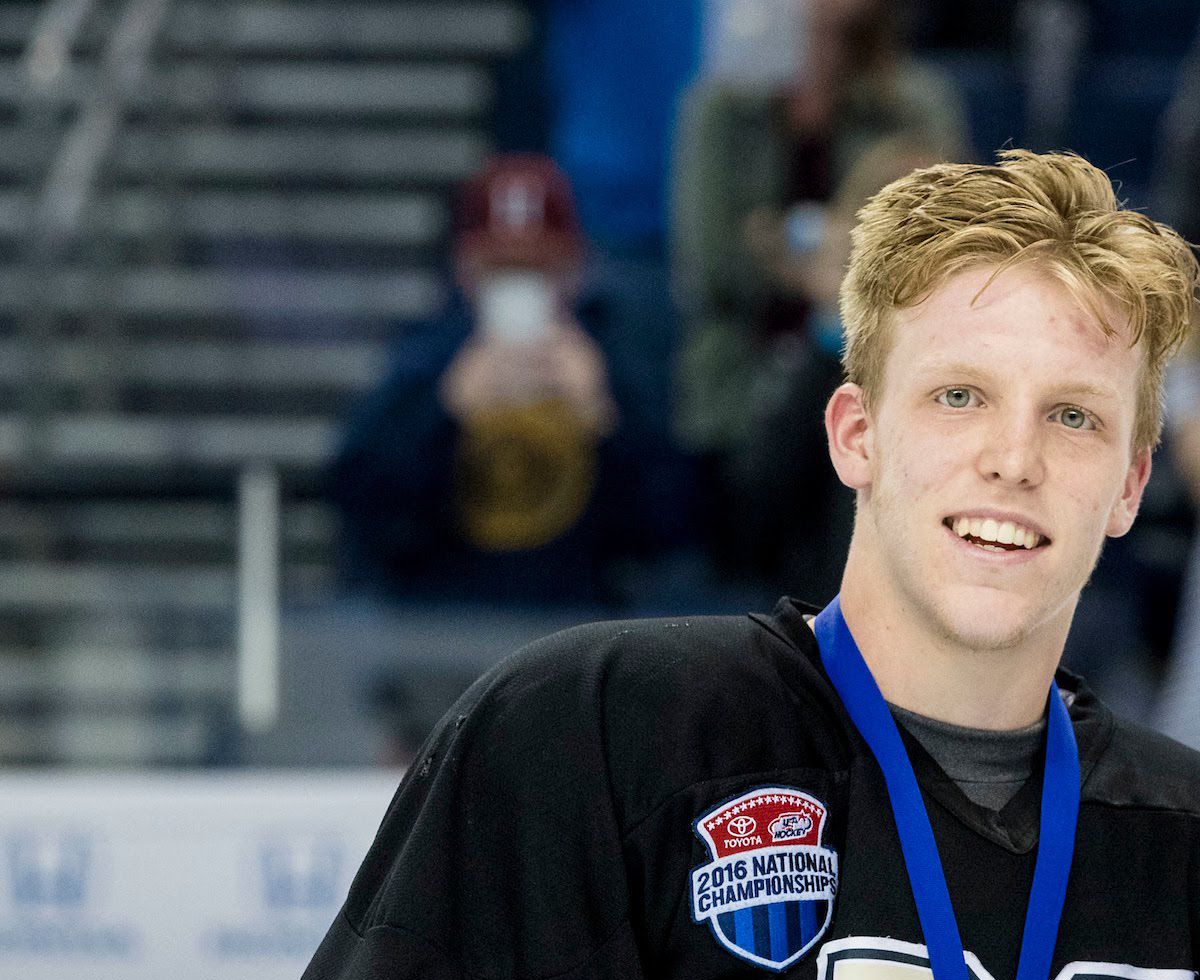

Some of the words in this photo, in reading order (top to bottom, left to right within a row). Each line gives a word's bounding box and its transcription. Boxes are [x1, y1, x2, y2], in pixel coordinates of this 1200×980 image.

[724, 835, 762, 848] TOYOTA
[774, 828, 806, 838] HOCKEY
[697, 860, 748, 895] 2016
[752, 852, 836, 878] NATIONAL
[698, 874, 837, 913] CHAMPIONSHIPS
